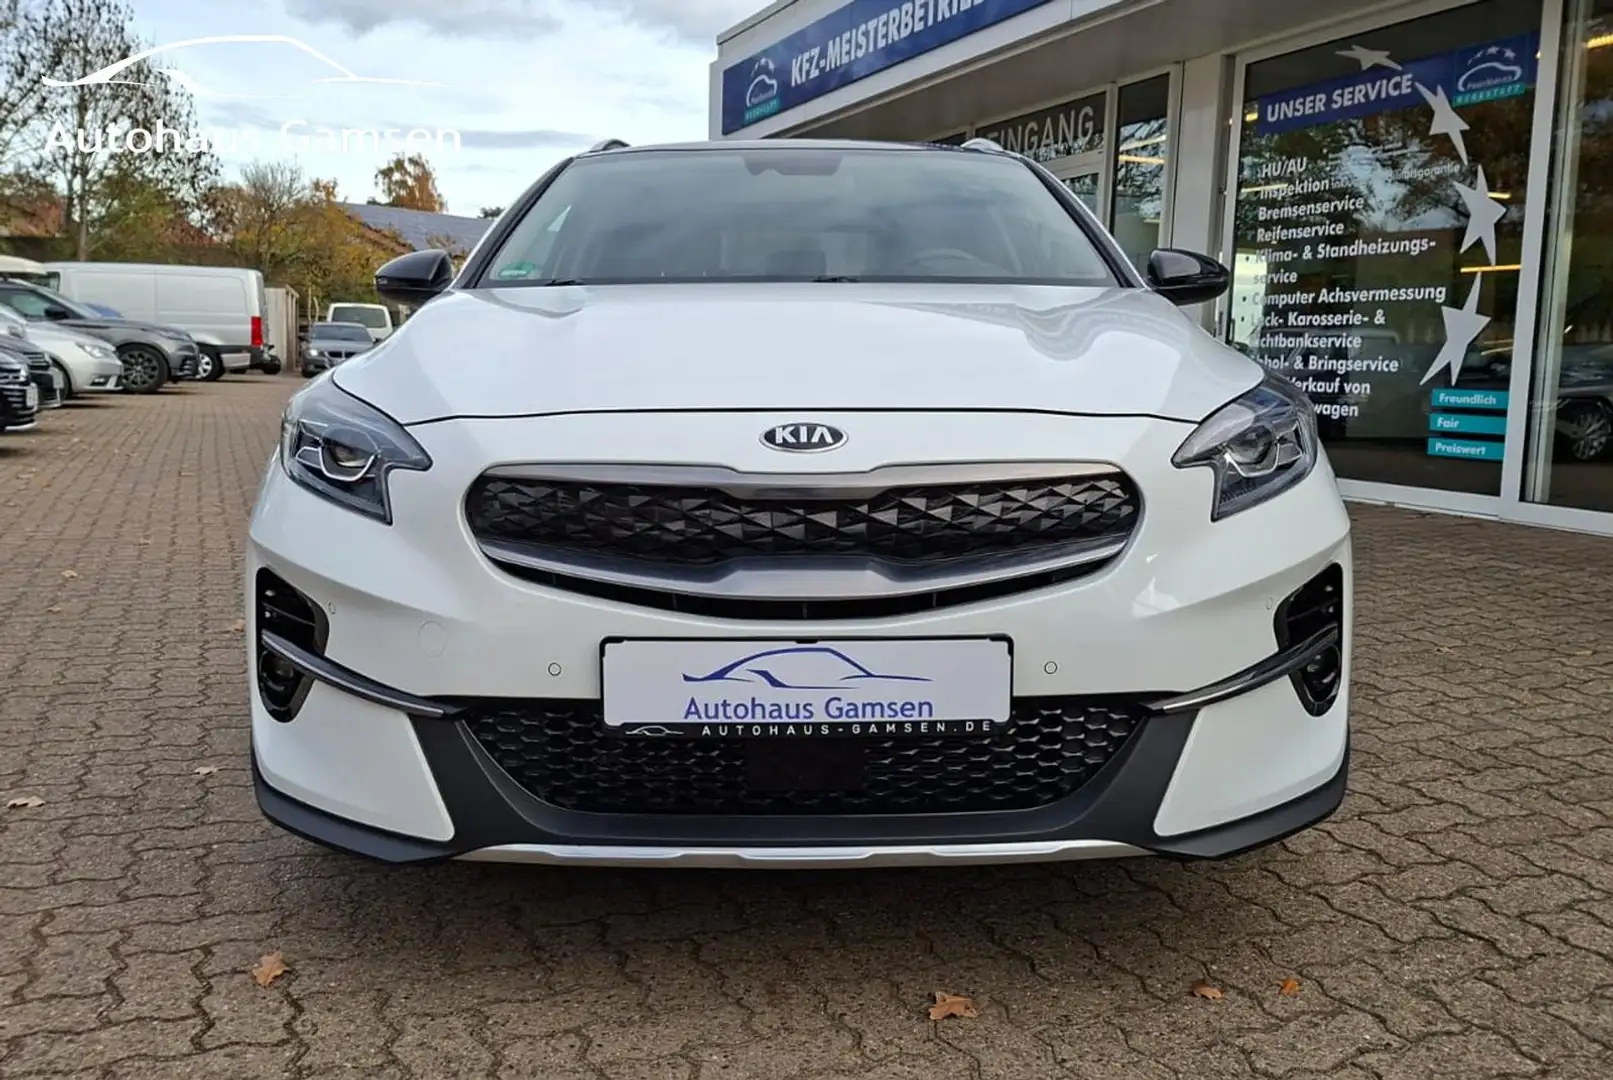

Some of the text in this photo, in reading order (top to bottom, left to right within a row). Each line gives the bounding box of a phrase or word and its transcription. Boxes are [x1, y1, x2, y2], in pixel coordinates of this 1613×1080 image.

[791, 0, 985, 87] KFZ-MEISTERBETRI
[1267, 74, 1413, 122] UNSER SERVICE
[987, 106, 1095, 152] INGANG
[1261, 156, 1307, 178] HU/AU
[1260, 177, 1330, 200] Inspektion
[1258, 195, 1365, 220] Bremsenservice
[1256, 220, 1345, 243] Reifenservice
[1302, 244, 1313, 260] &
[1317, 238, 1437, 258] Standheizungs-
[1318, 286, 1446, 304] Achsvermessung
[1287, 309, 1369, 327] Karosserie-
[1374, 308, 1386, 325] &
[1293, 355, 1304, 370] &
[1308, 355, 1400, 374] Bringservice
[1344, 381, 1371, 395] von
[1439, 393, 1497, 405] Freundlich
[1436, 417, 1460, 429] Fair
[775, 425, 834, 444] KIA
[1435, 442, 1487, 456] Preiswert
[683, 697, 935, 721] Autohaus Gamsen
[701, 720, 992, 737] AUTOHAUS-GAMSEN.DE
